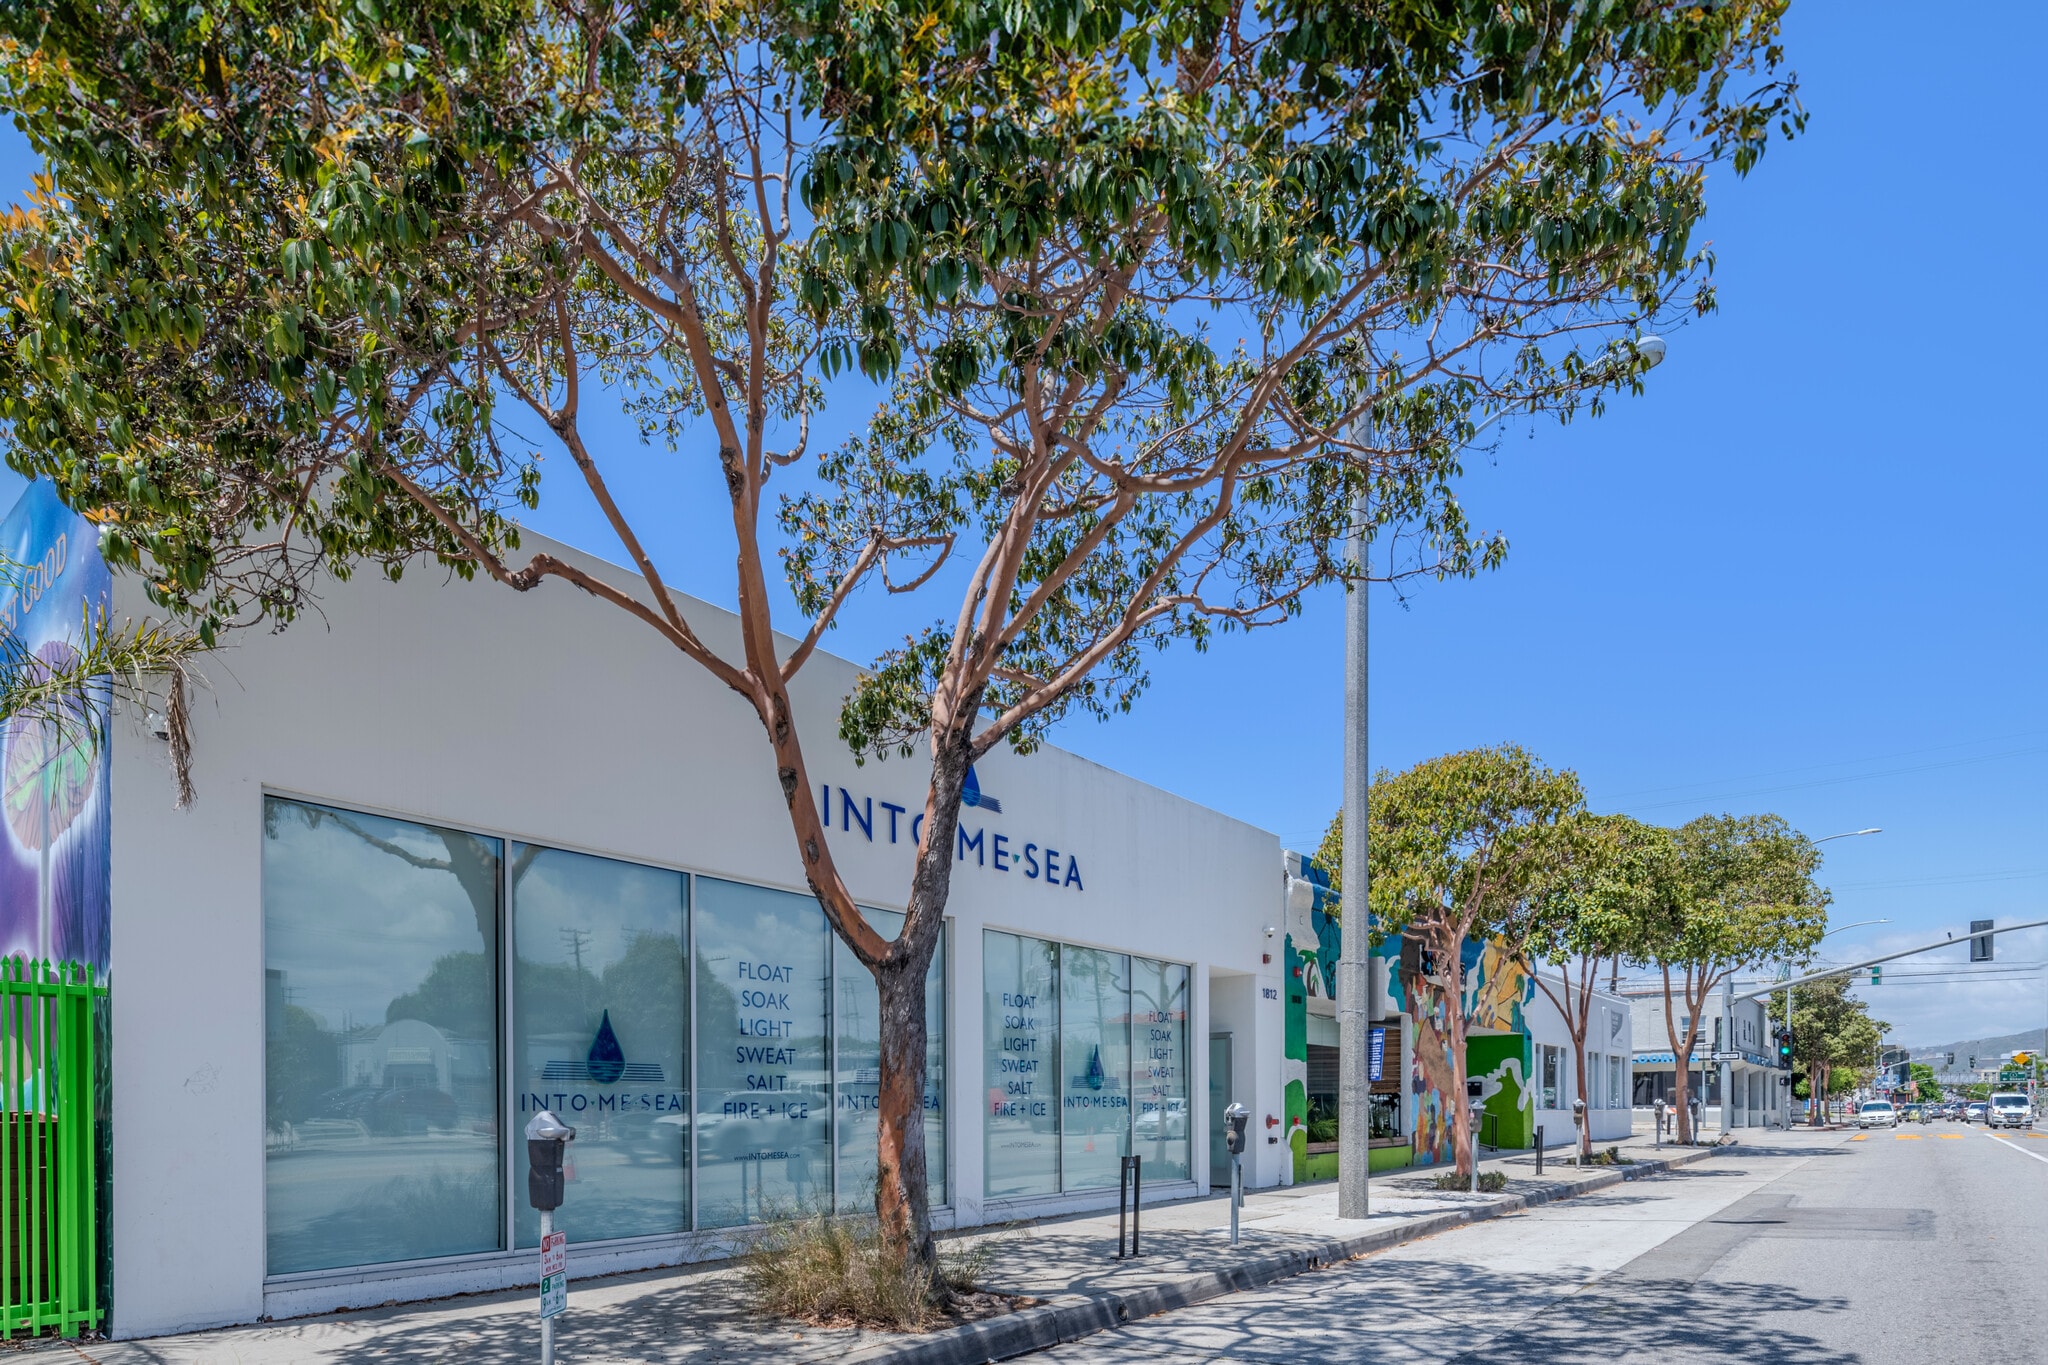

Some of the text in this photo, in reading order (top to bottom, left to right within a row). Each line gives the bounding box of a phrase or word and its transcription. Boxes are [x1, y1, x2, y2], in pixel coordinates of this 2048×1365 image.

[22, 532, 67, 615] GOOD
[738, 961, 793, 983] FLOAT
[742, 990, 790, 1010] SOAK
[1003, 993, 1036, 1009] FLOAT
[1262, 987, 1278, 1001] 1812
[1005, 1015, 1035, 1031] SOAK
[1148, 1010, 1174, 1023] FLOAT
[739, 1018, 793, 1037] LIGHT
[1150, 1029, 1172, 1042] SOAK
[1003, 1037, 1037, 1052] LIGHT
[736, 1046, 796, 1065] SWEAT
[1149, 1047, 1174, 1060] LIGHT
[1001, 1058, 1039, 1073] SWEAT
[1148, 1066, 1175, 1078] SWEAT
[747, 1074, 787, 1092] SALT
[1008, 1081, 1033, 1095] SALT
[1152, 1085, 1171, 1096] SALT
[723, 1102, 760, 1119] FIRE
[782, 1102, 808, 1119] ICE
[994, 1102, 1016, 1117] FIRE
[1029, 1102, 1046, 1117] ICE
[543, 1280, 549, 1292] 2
